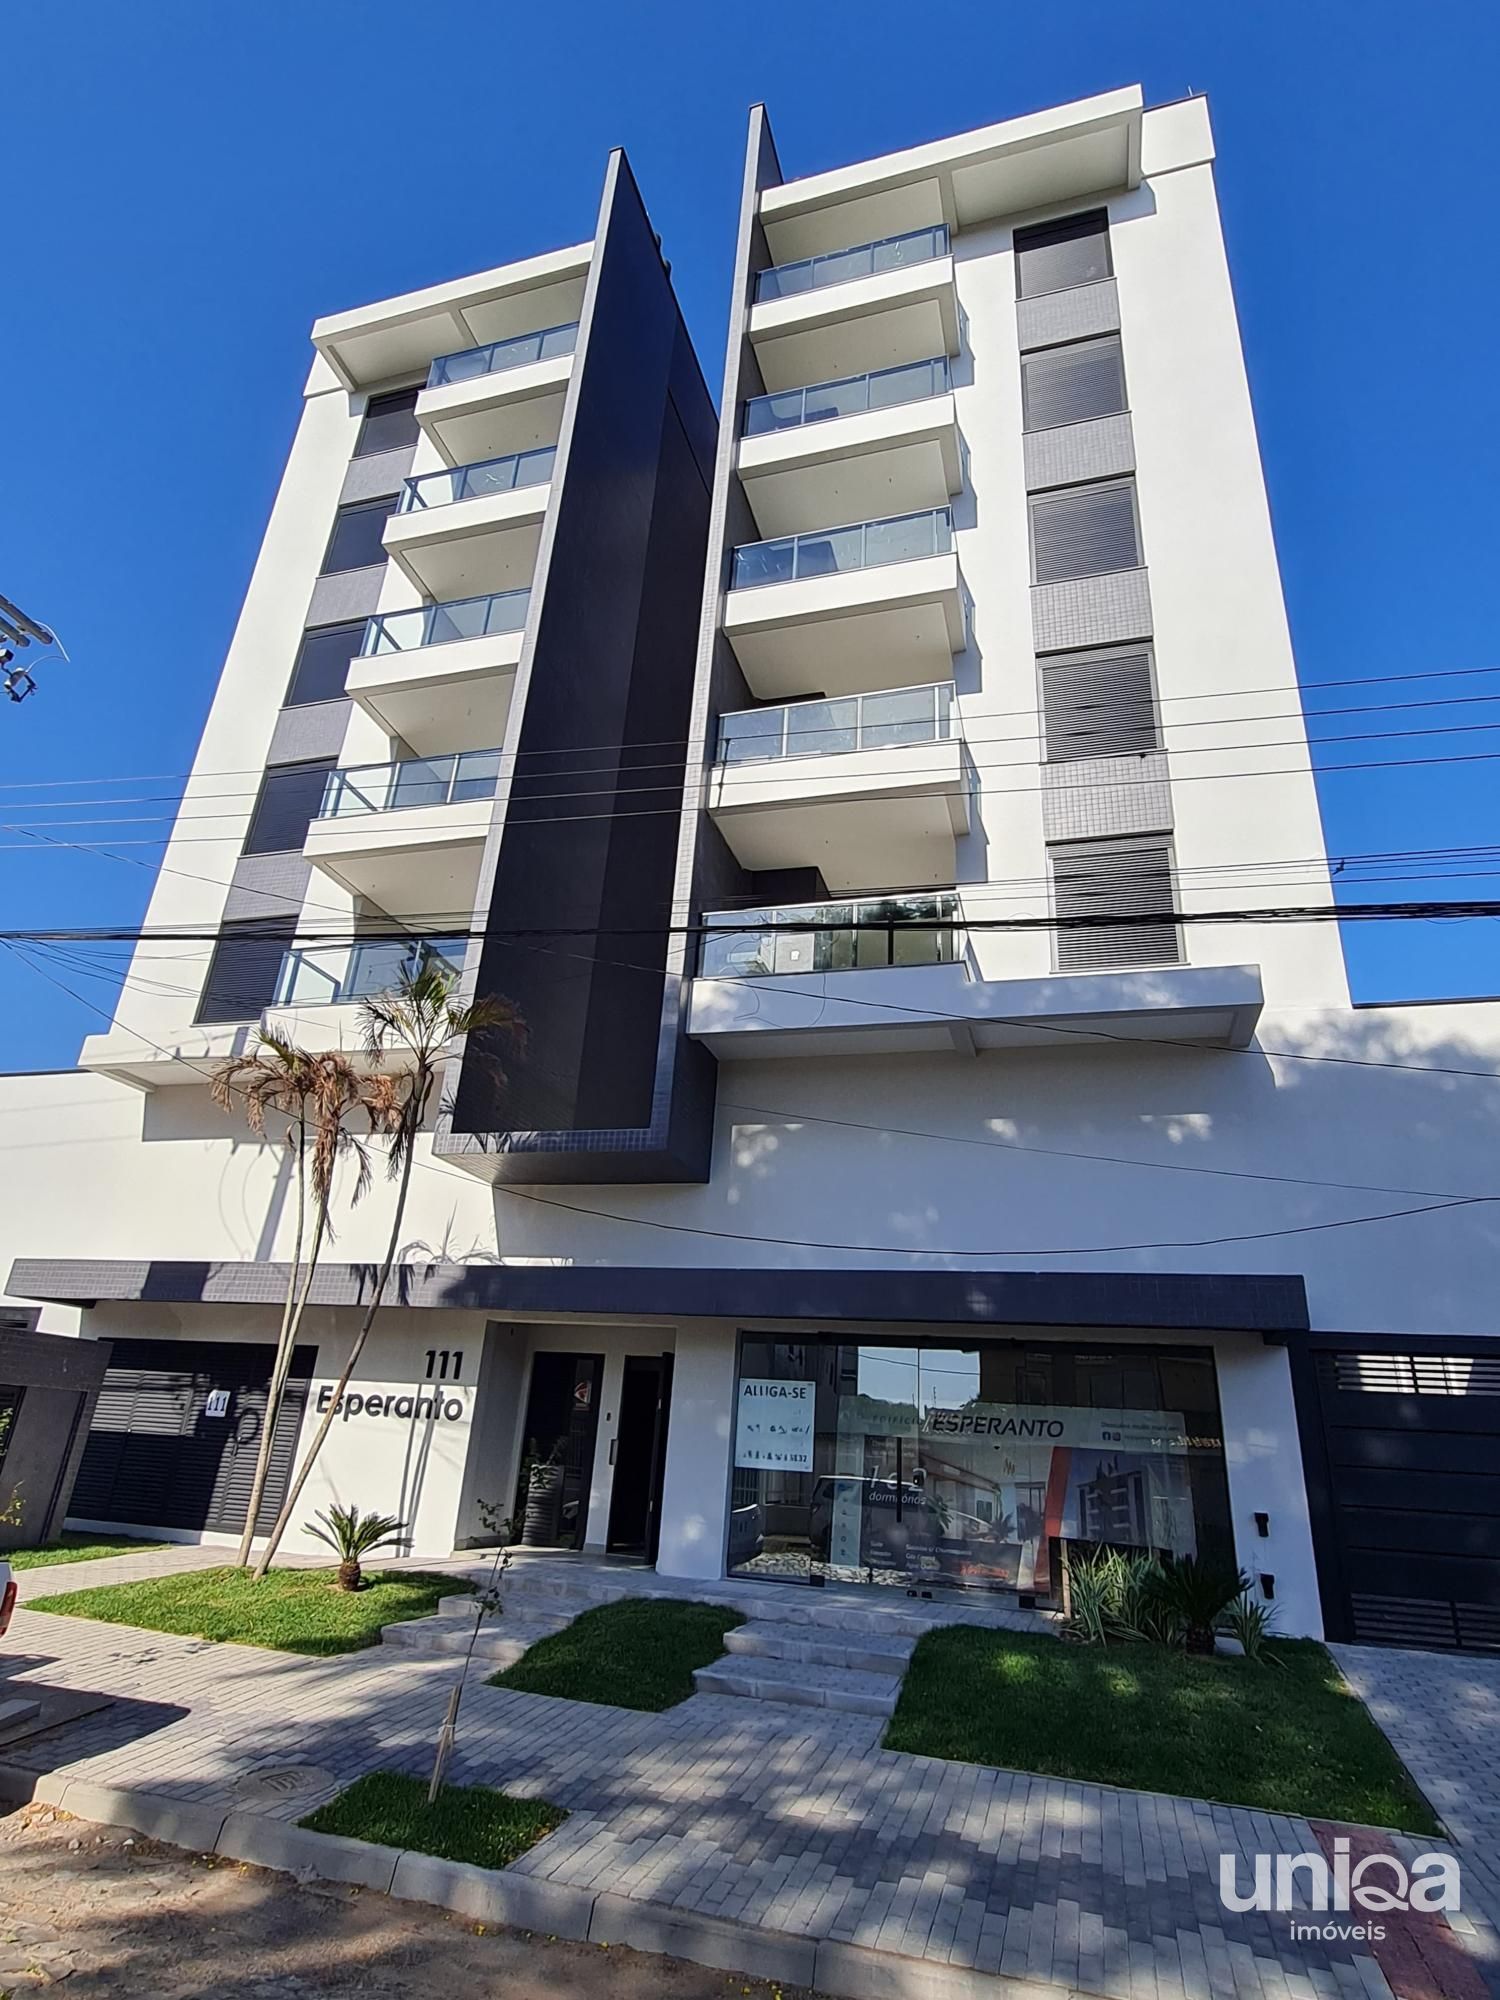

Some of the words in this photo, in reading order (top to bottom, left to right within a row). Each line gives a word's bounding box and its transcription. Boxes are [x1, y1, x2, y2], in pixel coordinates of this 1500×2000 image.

[425, 1350, 463, 1379] 111
[208, 1396, 227, 1411] 111
[316, 1385, 463, 1422] Esperanto
[932, 1414, 1064, 1438] ESPERANTO
